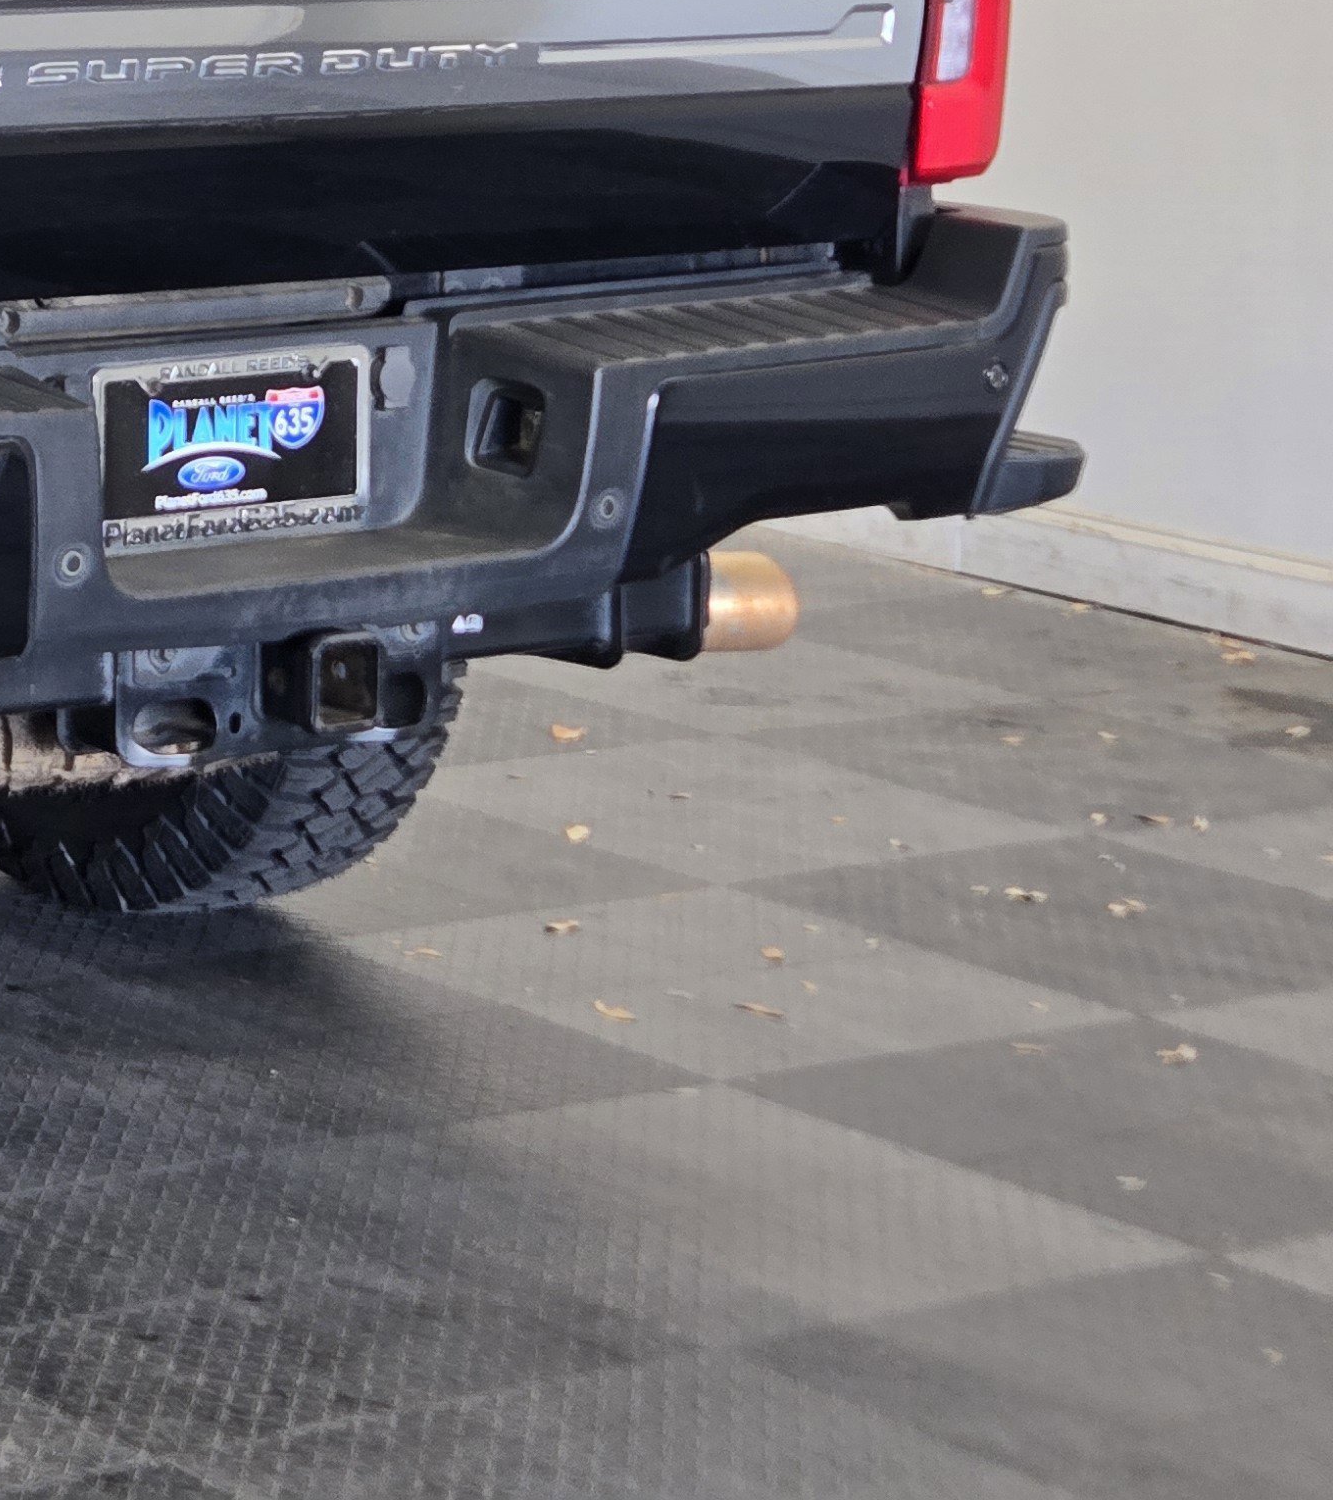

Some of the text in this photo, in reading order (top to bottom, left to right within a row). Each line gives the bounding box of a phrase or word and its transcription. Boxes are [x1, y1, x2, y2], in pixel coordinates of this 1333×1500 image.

[27, 42, 519, 86] SUPER DUTY
[159, 361, 240, 381] RANDALL
[147, 399, 315, 465] PLANET 635
[190, 462, 230, 483] Ford
